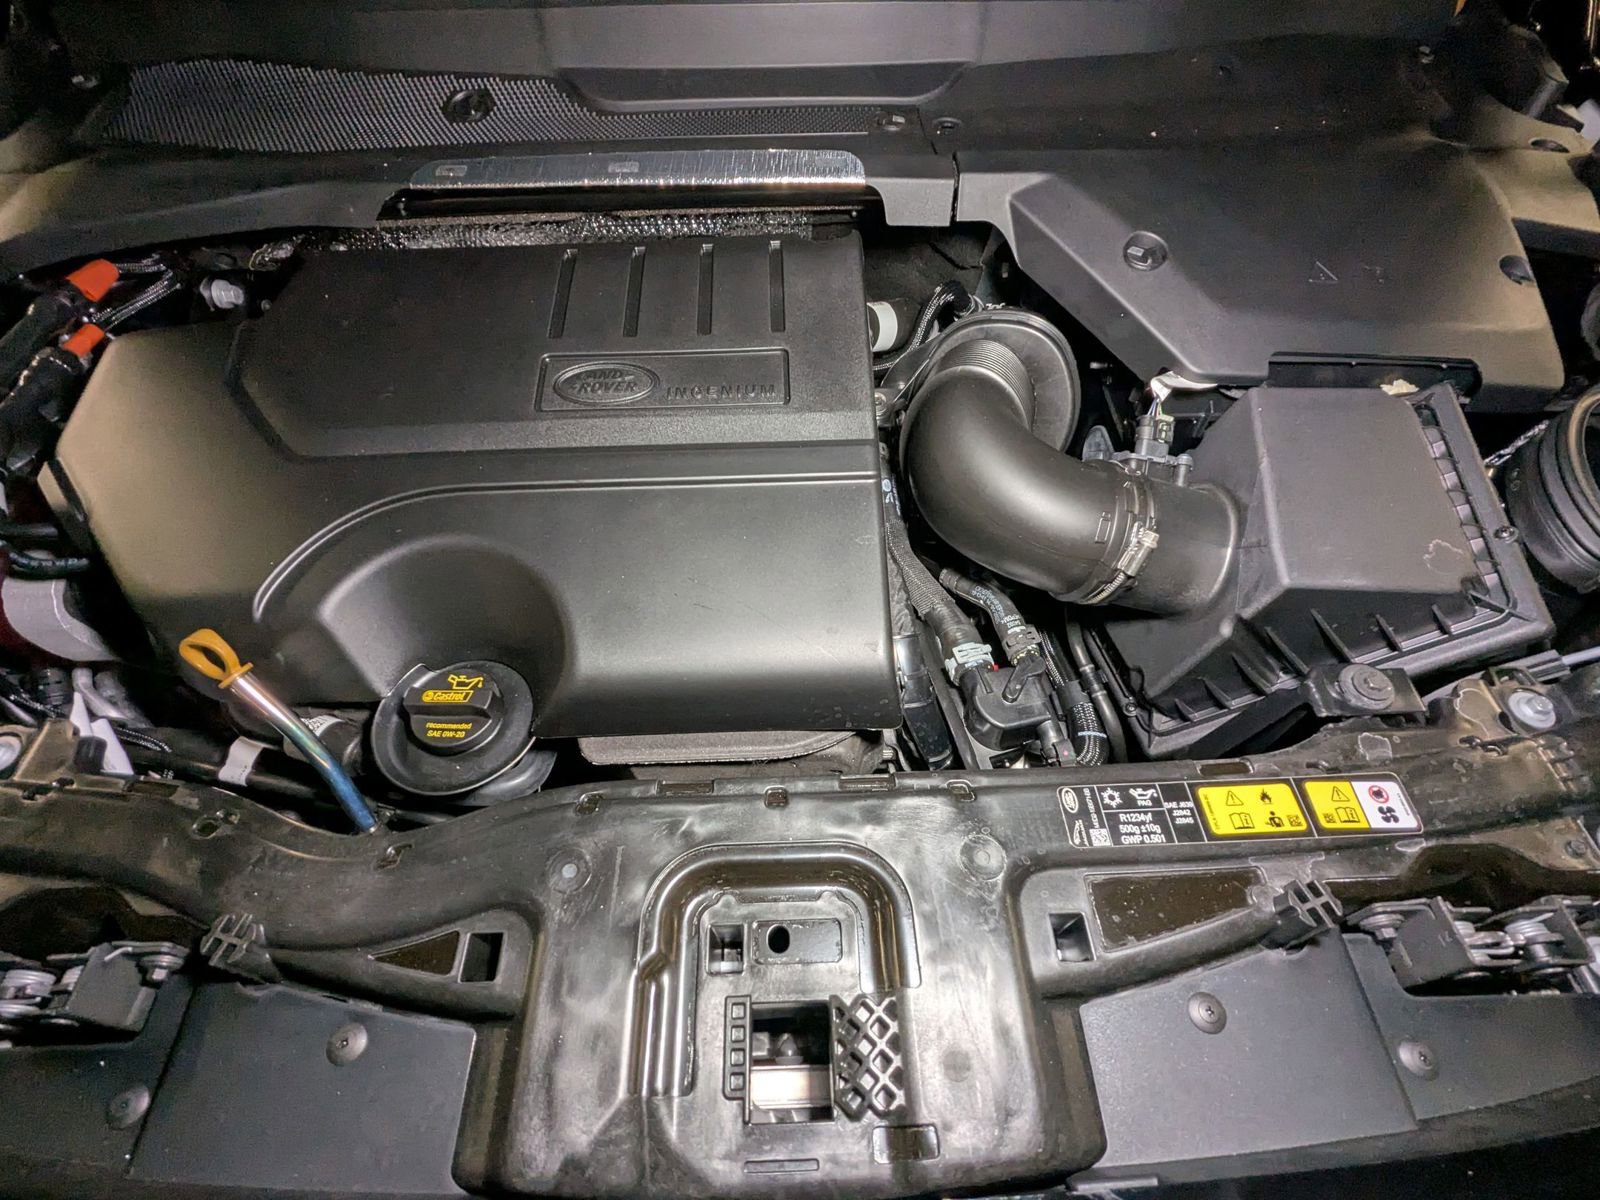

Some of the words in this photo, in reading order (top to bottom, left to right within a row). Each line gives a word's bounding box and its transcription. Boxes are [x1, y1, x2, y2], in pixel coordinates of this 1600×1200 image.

[577, 381, 637, 395] ROVER
[665, 383, 776, 400] INGENIUM
[434, 692, 465, 700] Castrol
[426, 722, 472, 730] recommended
[1119, 812, 1153, 823] R1234yf
[1119, 824, 1140, 834] 500g
[1121, 834, 1142, 844] GWP
[1143, 834, 1166, 843] 0.501
